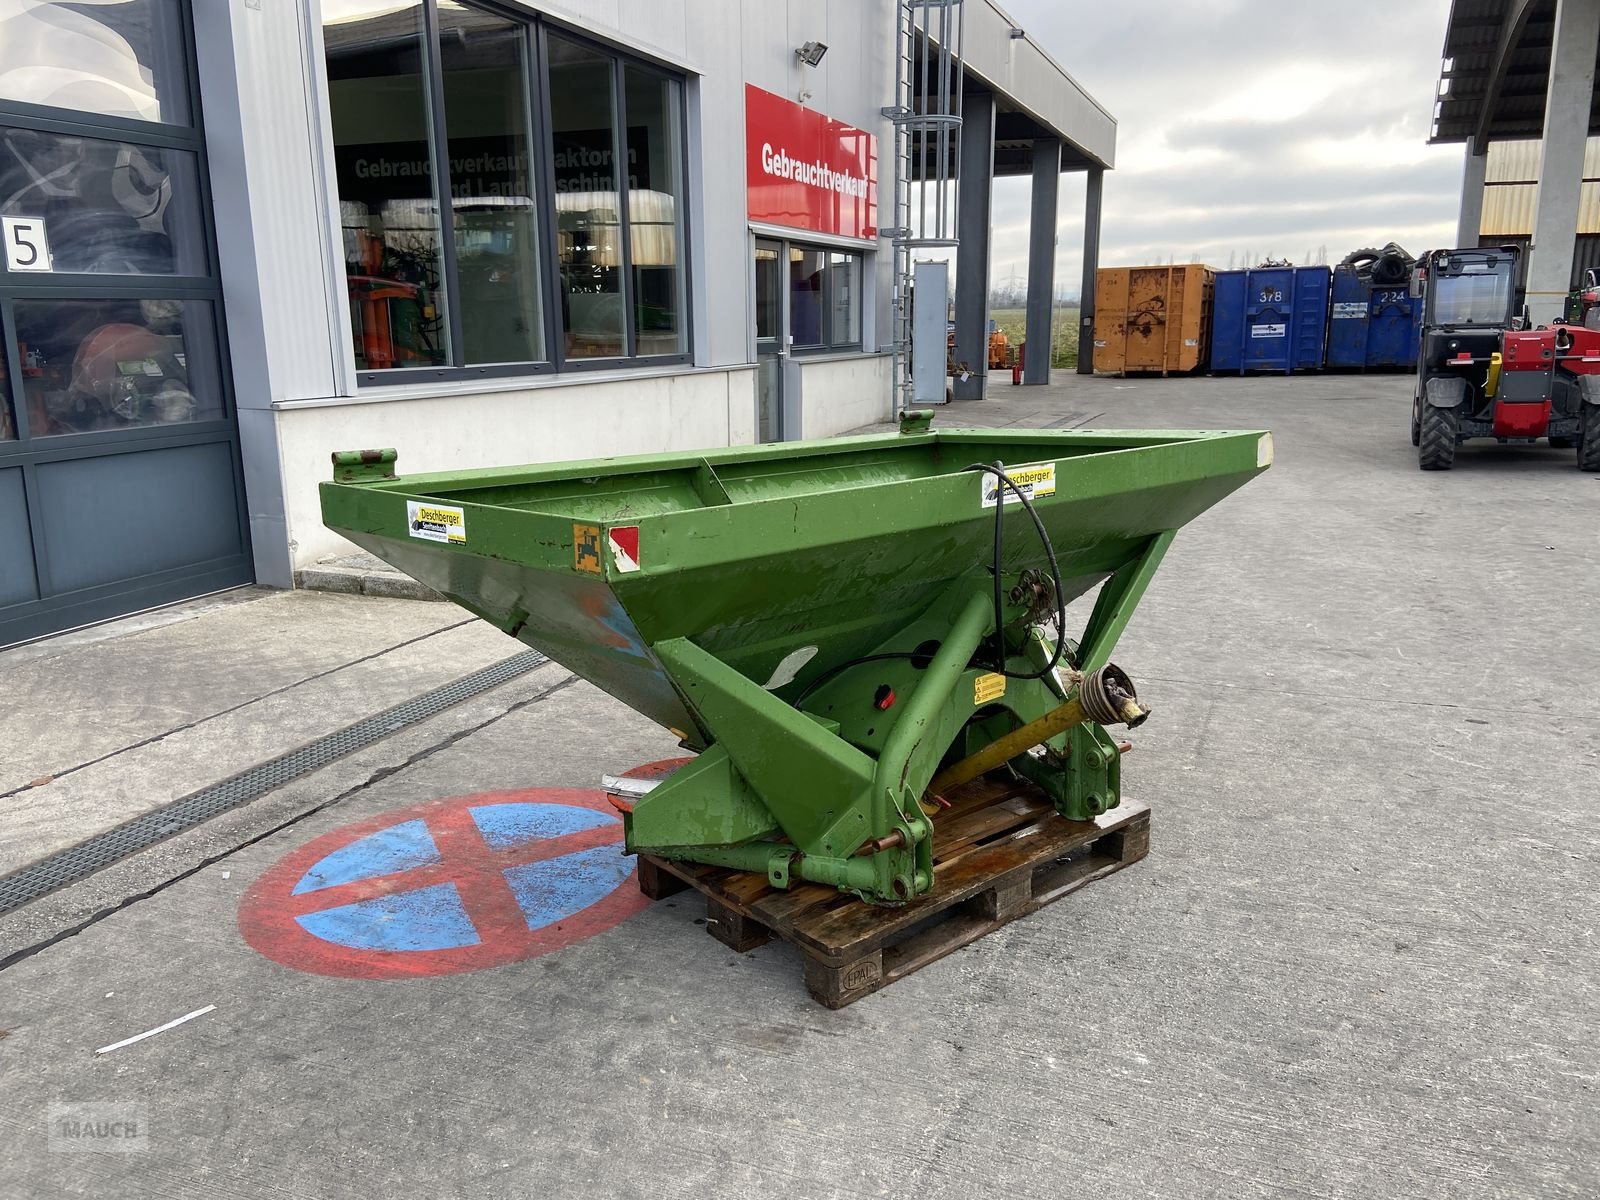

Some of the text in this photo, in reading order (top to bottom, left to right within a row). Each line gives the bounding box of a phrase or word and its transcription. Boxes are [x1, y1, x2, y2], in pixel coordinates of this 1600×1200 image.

[355, 152, 528, 178] Gebrauctverkauf
[762, 142, 868, 198] Gebrauchtverkauf
[13, 225, 37, 266] 5
[1259, 291, 1282, 302] 378
[1380, 291, 1405, 303] 224
[1004, 471, 1049, 485] schberger
[421, 509, 459, 526] Deschberger
[847, 965, 872, 988] EPAL
